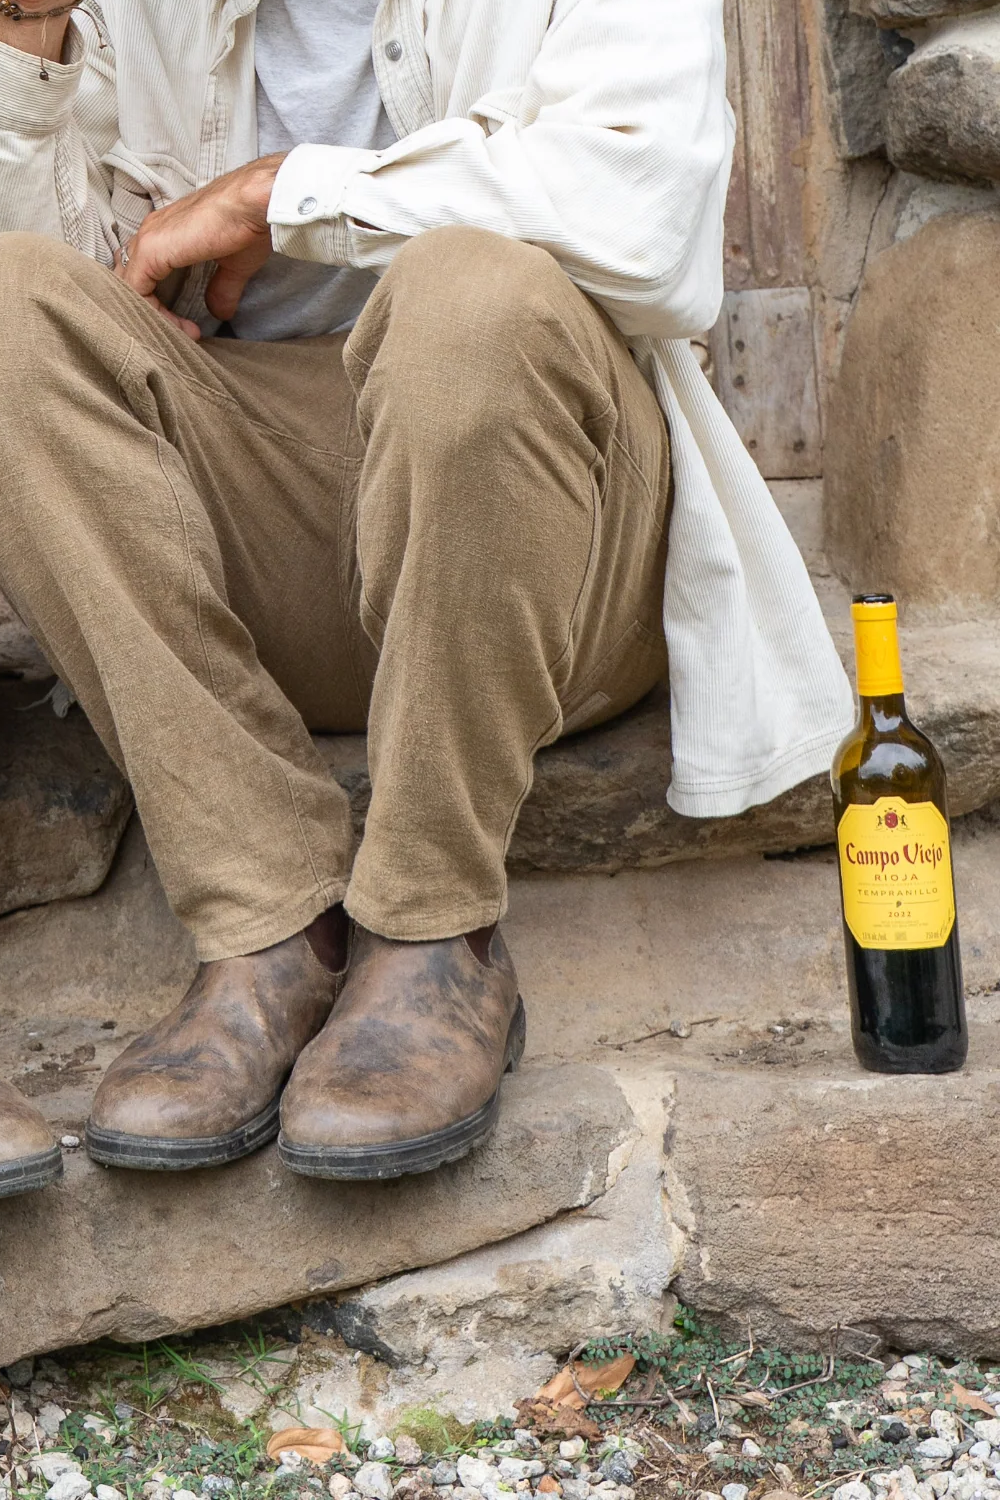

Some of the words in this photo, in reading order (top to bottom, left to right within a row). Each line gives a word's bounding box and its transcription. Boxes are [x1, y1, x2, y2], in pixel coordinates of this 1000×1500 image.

[845, 842, 900, 873] Campo
[902, 842, 943, 870] Viejo
[874, 874, 918, 882] RIOJA
[857, 887, 938, 897] TEMPRANILLO
[888, 910, 912, 918] 2022
